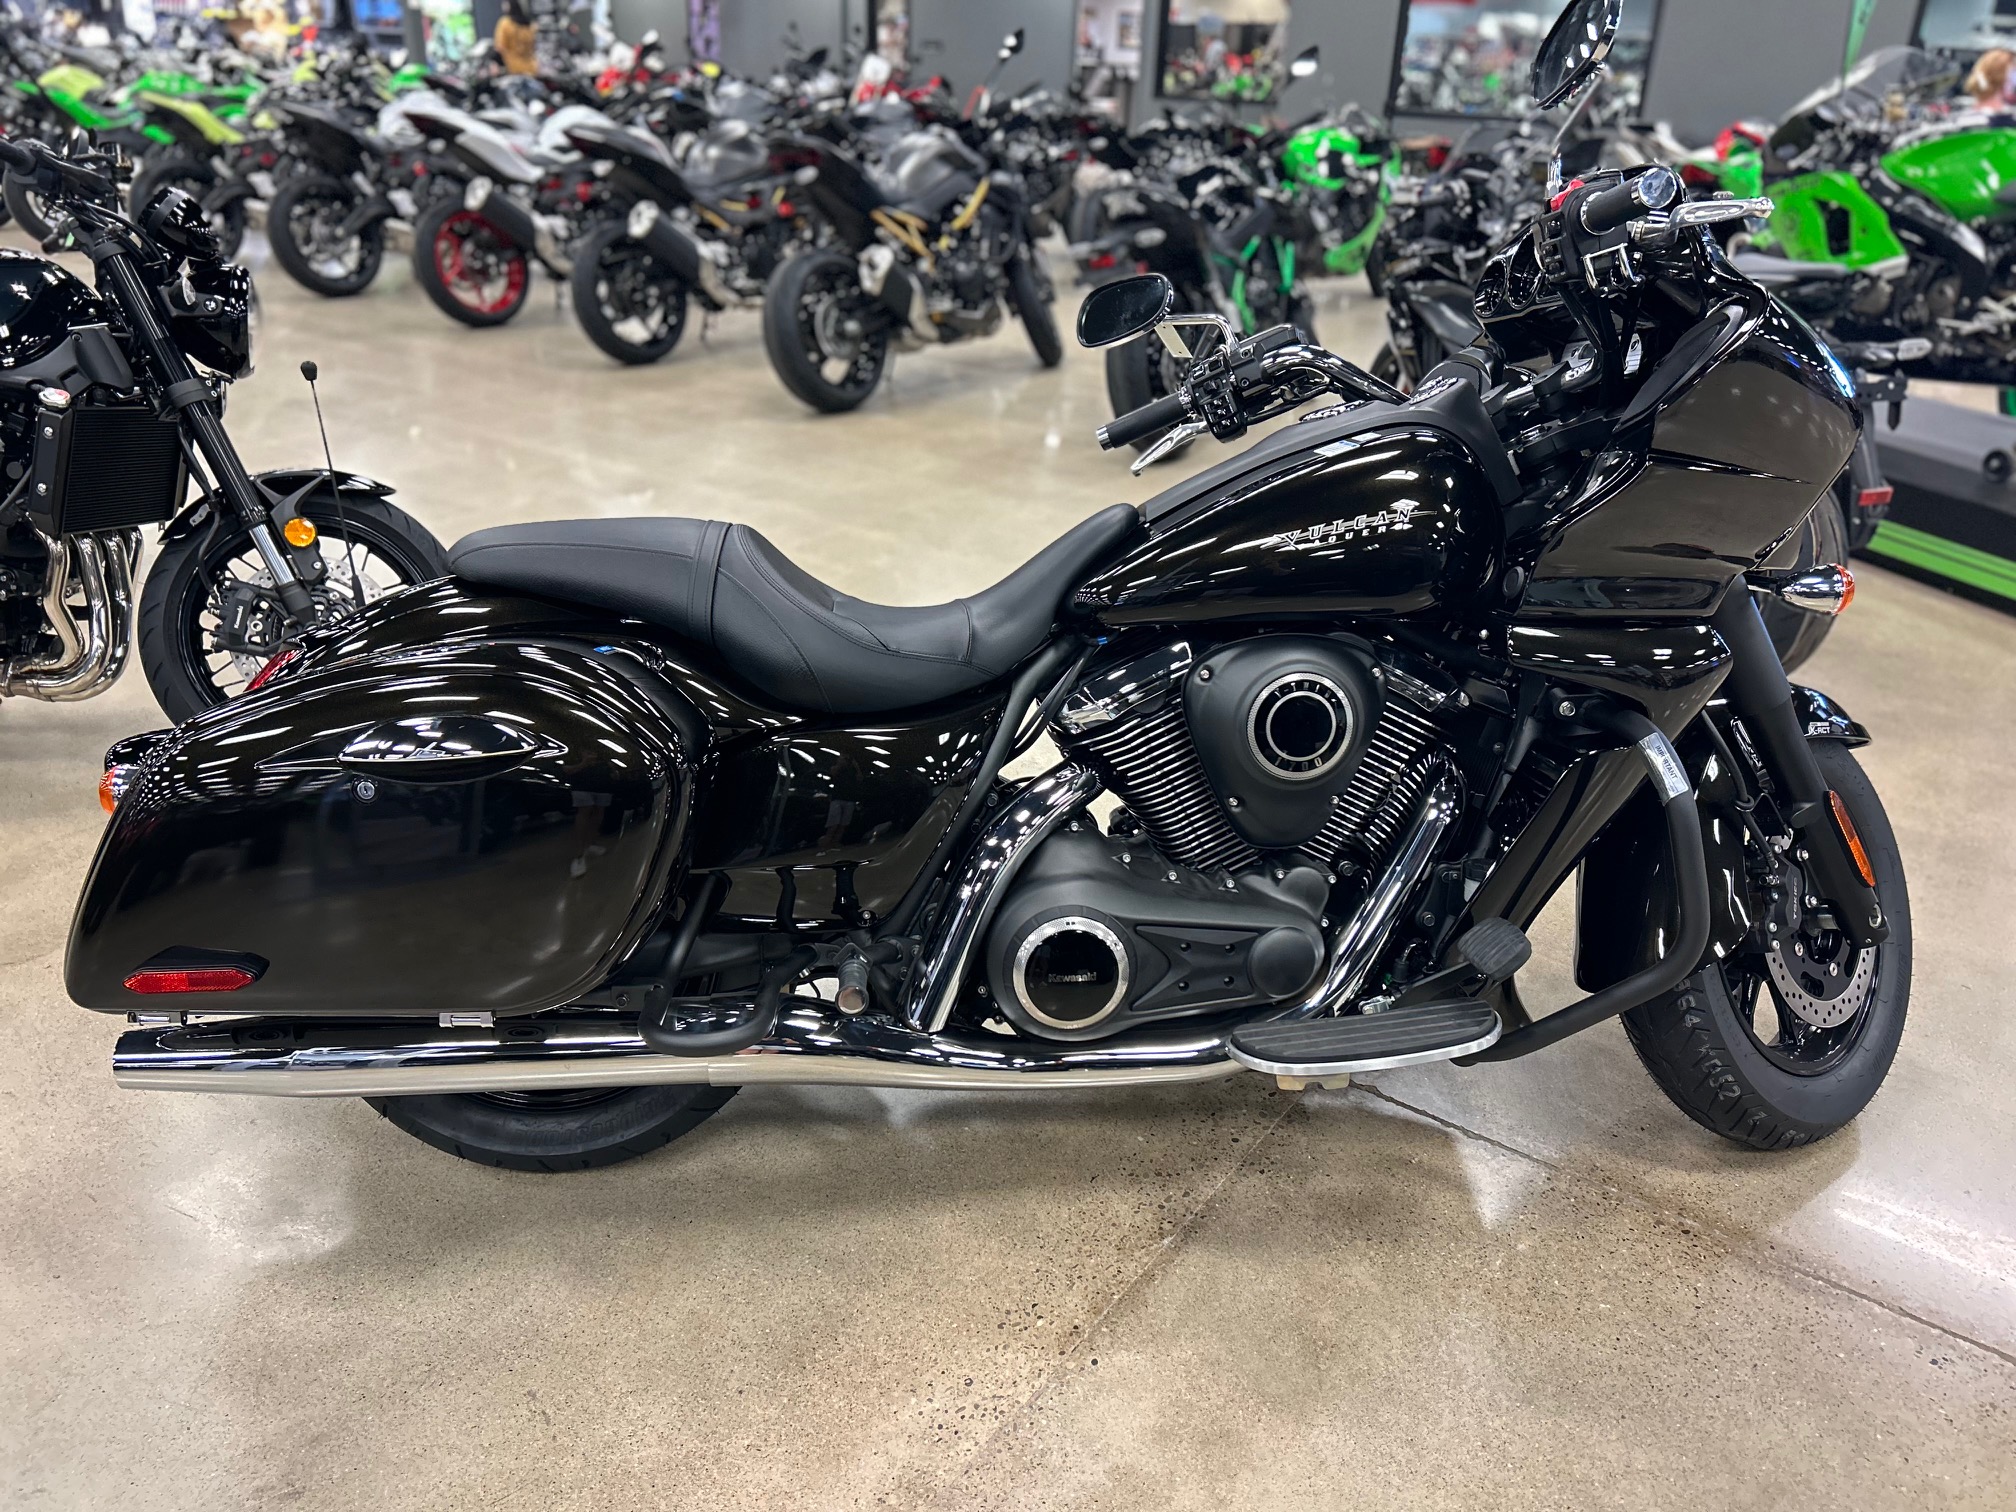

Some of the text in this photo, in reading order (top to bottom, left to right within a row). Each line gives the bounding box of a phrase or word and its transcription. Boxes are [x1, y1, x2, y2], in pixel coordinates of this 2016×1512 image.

[1280, 506, 1415, 550] VULCAN
[1274, 681, 1331, 698] V-TWIN
[1274, 756, 1323, 771] 1700
[1048, 971, 1097, 983] Kawasaki
